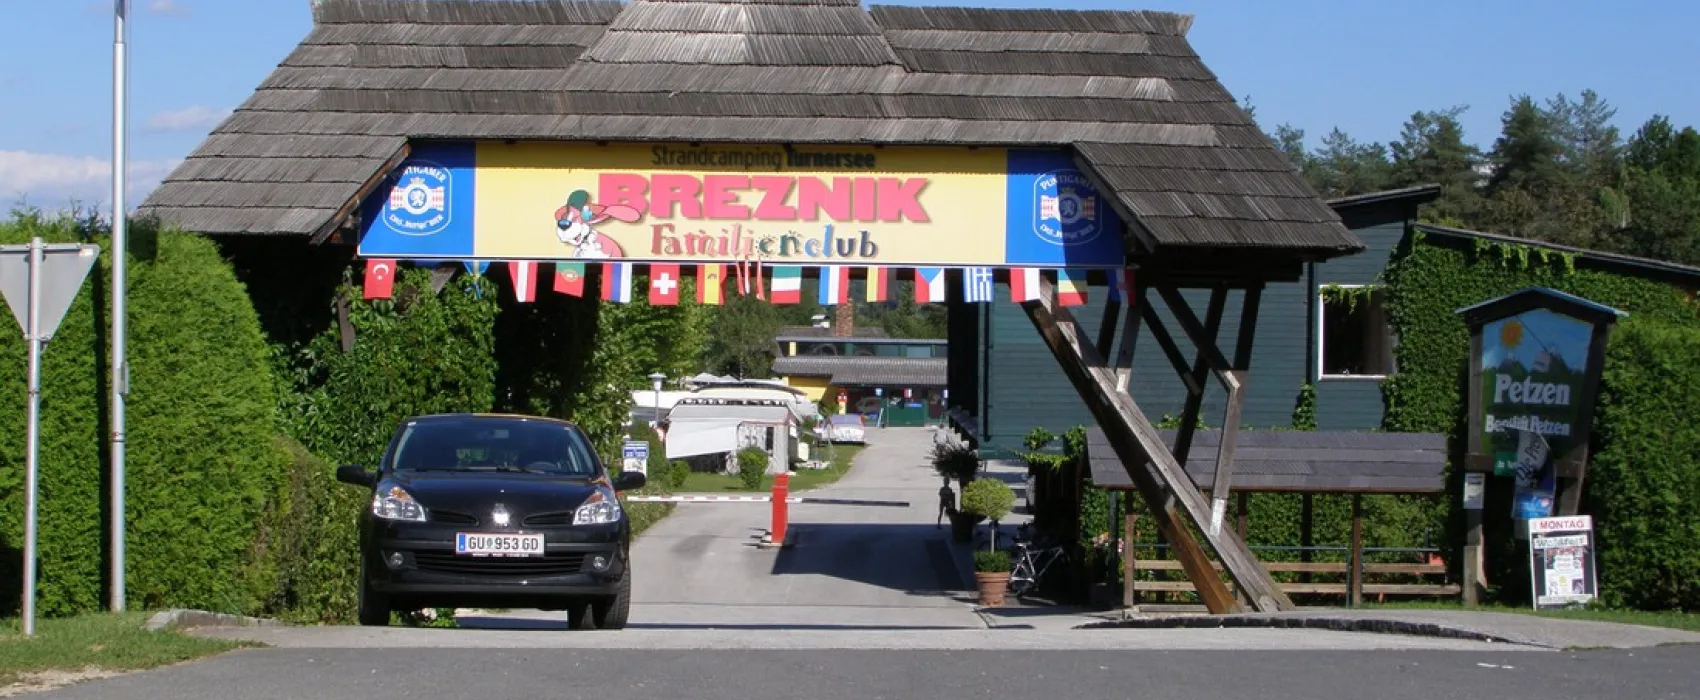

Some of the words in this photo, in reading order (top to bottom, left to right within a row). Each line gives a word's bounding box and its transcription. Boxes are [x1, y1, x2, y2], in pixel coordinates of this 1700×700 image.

[652, 145, 782, 171] Strandcamping
[599, 172, 931, 223] BREZNIK
[650, 222, 879, 258] Familienclub
[1493, 373, 1571, 405] Petzen
[1540, 519, 1584, 530] MONTAG
[468, 536, 485, 550] GU
[494, 537, 519, 550] 953
